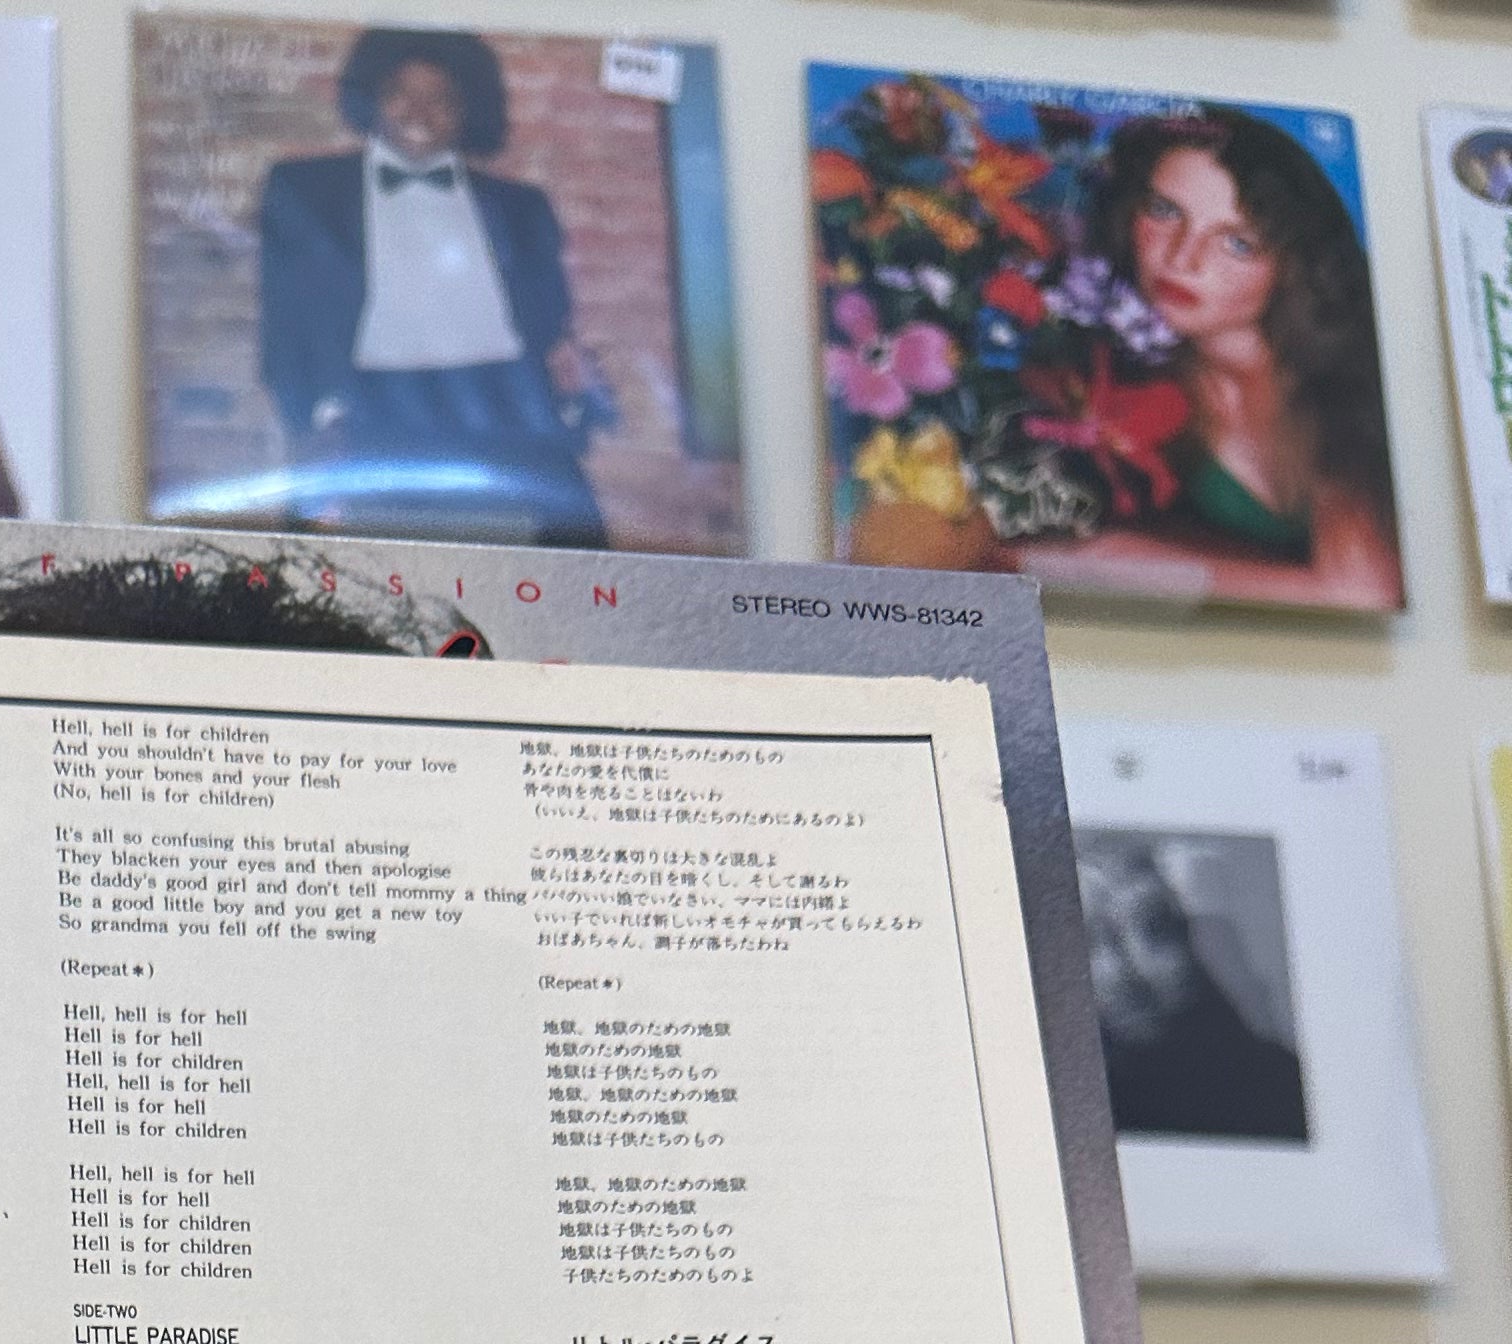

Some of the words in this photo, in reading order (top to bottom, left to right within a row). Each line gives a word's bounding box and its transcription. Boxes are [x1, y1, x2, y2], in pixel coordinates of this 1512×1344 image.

[731, 594, 832, 620] STEREO
[842, 599, 984, 629] WWS-81342
[58, 913, 82, 930] So
[91, 916, 169, 934] grandma
[178, 922, 210, 937] you
[219, 919, 247, 937] fell
[256, 921, 281, 938] off
[290, 923, 317, 940] the
[325, 926, 377, 945] swing
[75, 1325, 139, 1344] LITTLE
